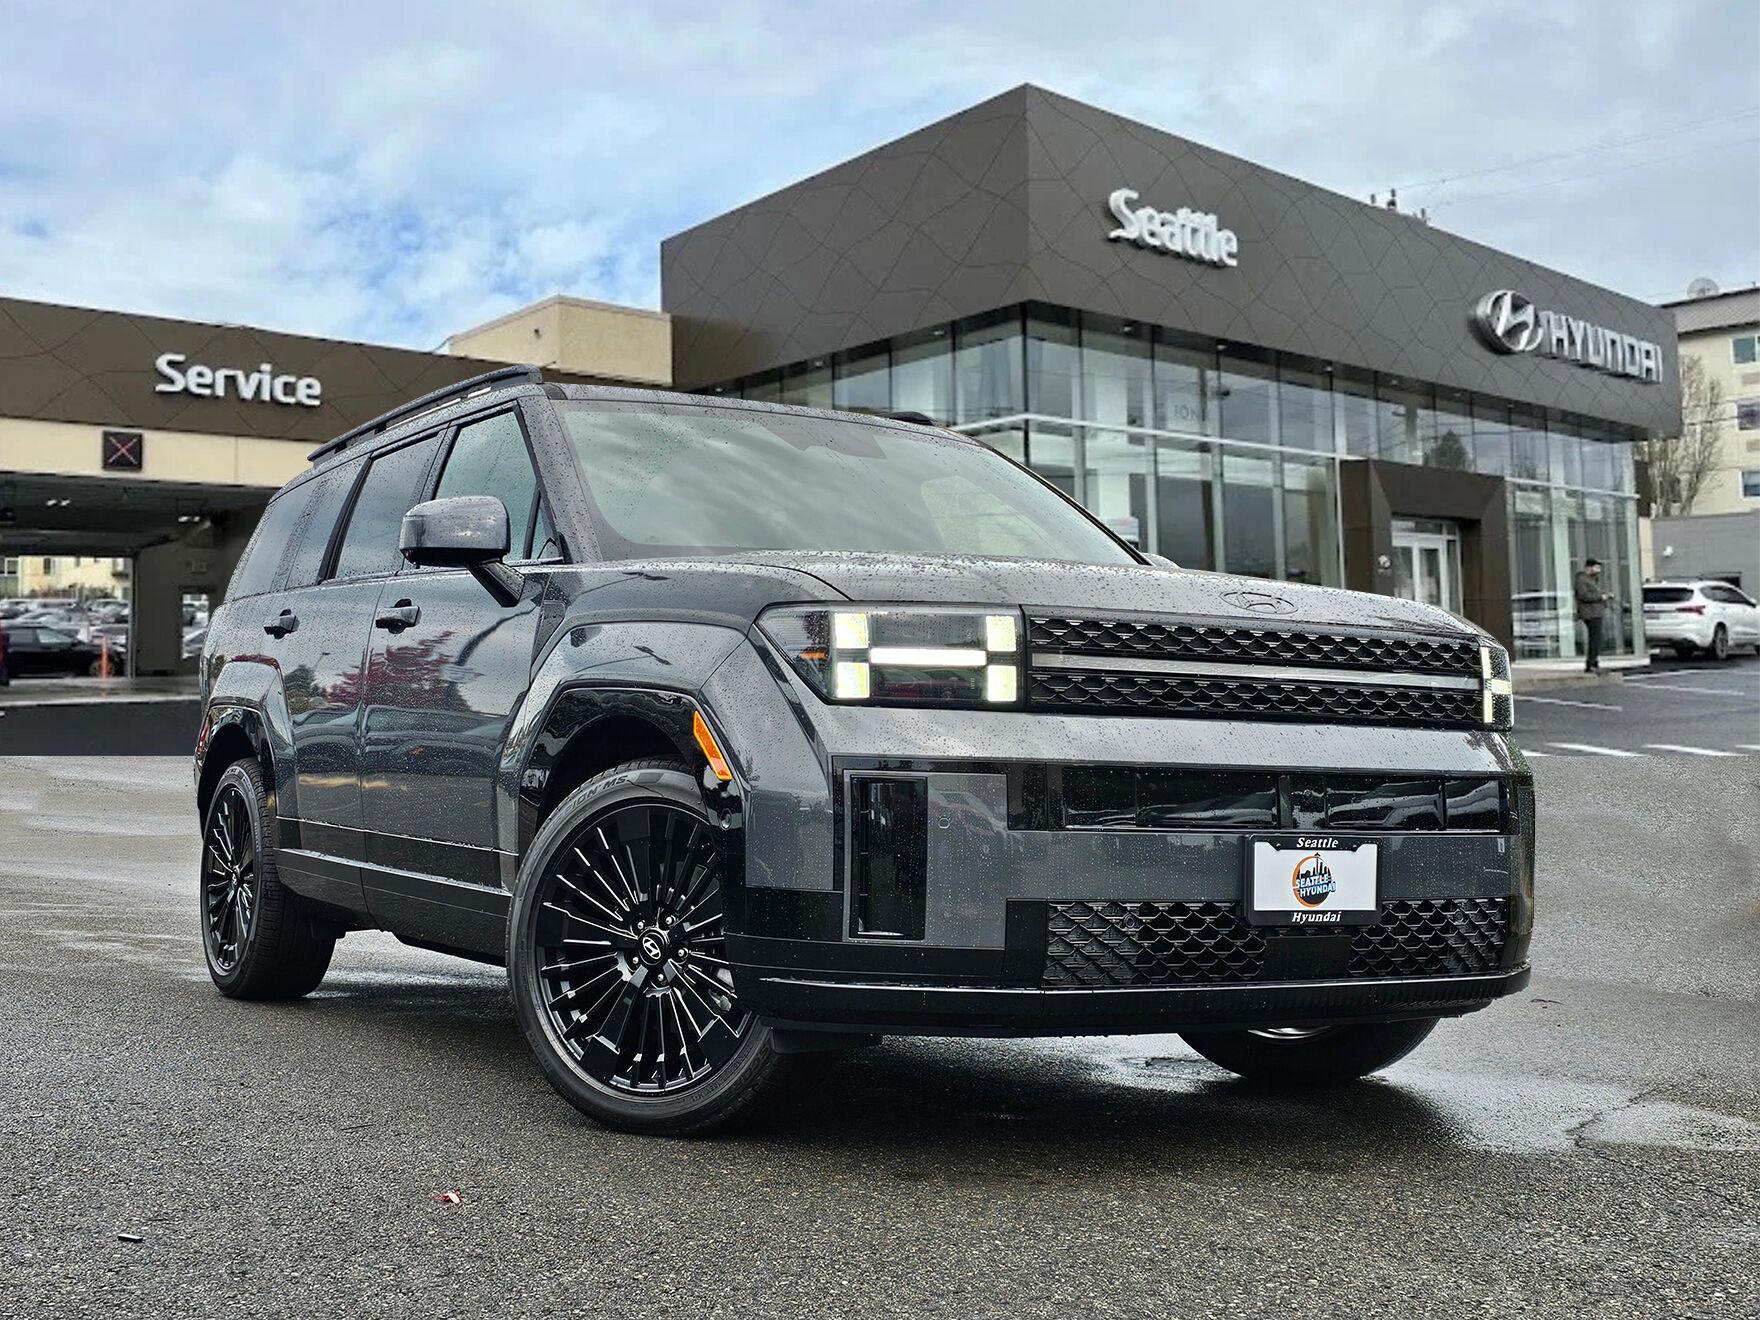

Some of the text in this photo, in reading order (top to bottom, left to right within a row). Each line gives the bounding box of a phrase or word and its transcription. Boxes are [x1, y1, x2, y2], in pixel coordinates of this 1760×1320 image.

[1108, 187, 1239, 267] Seattle
[1543, 311, 1663, 383] HYUNDAI
[155, 352, 322, 407] Service
[1296, 837, 1339, 848] Seattle
[1295, 873, 1329, 888] SEATTLE
[1300, 880, 1337, 897] HYUNDAI
[1292, 911, 1342, 925] Hyundai
